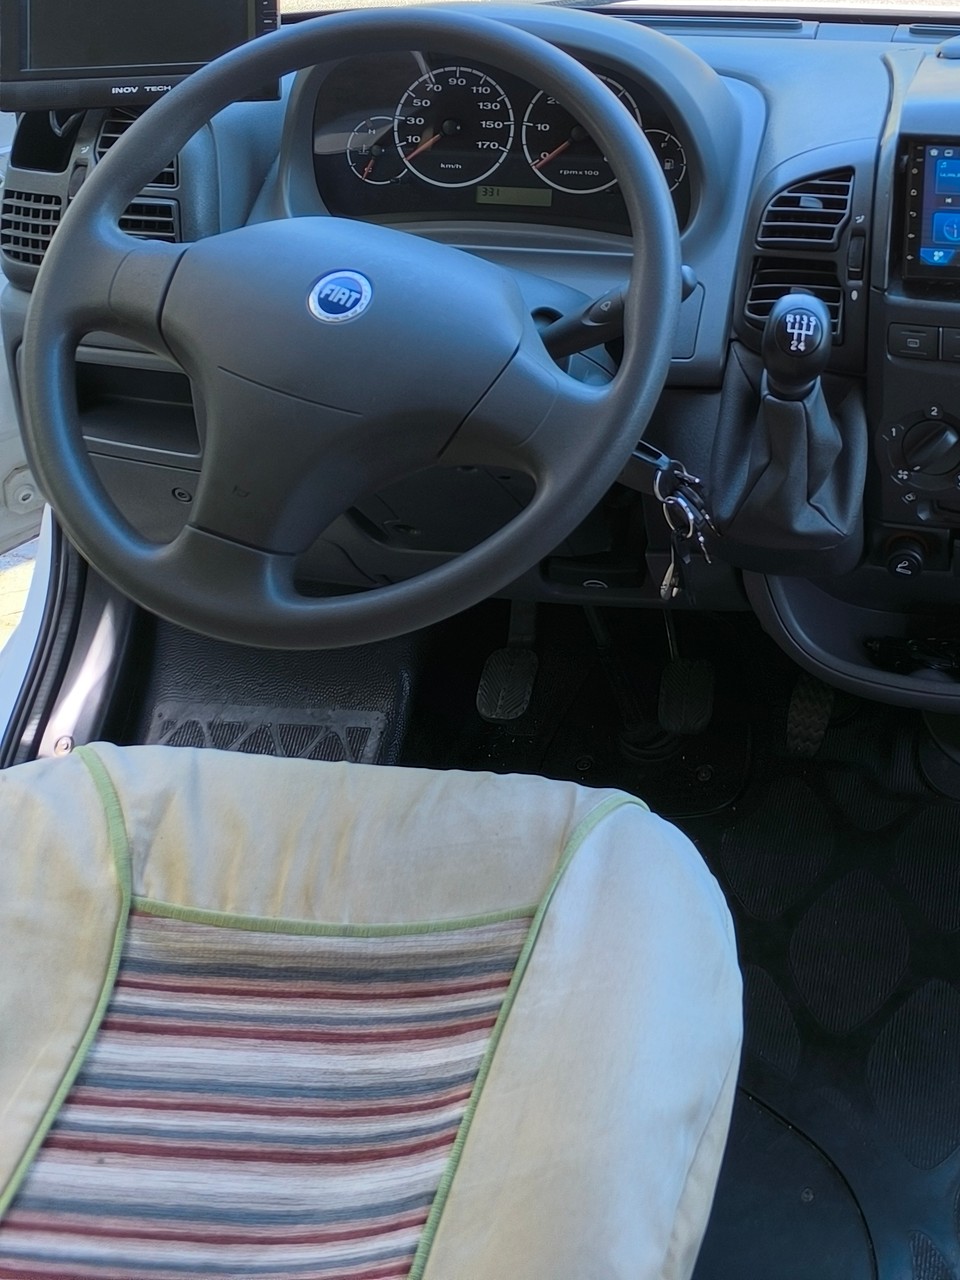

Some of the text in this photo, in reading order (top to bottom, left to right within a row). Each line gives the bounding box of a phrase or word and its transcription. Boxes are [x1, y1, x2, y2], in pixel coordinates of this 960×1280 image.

[448, 78, 467, 86] 90
[111, 86, 139, 94] INOV
[425, 84, 442, 92] 70
[470, 86, 491, 94] 110
[412, 99, 431, 107] 50
[546, 96, 561, 105] 2
[477, 102, 501, 110] 130
[406, 116, 425, 125] 30
[480, 120, 503, 129] 150
[535, 123, 550, 132] 10
[406, 135, 421, 143] 10
[476, 141, 499, 150] 170
[540, 151, 550, 160] 0
[319, 283, 361, 308] FIAT
[930, 406, 938, 416] 2
[891, 427, 896, 437] 1
